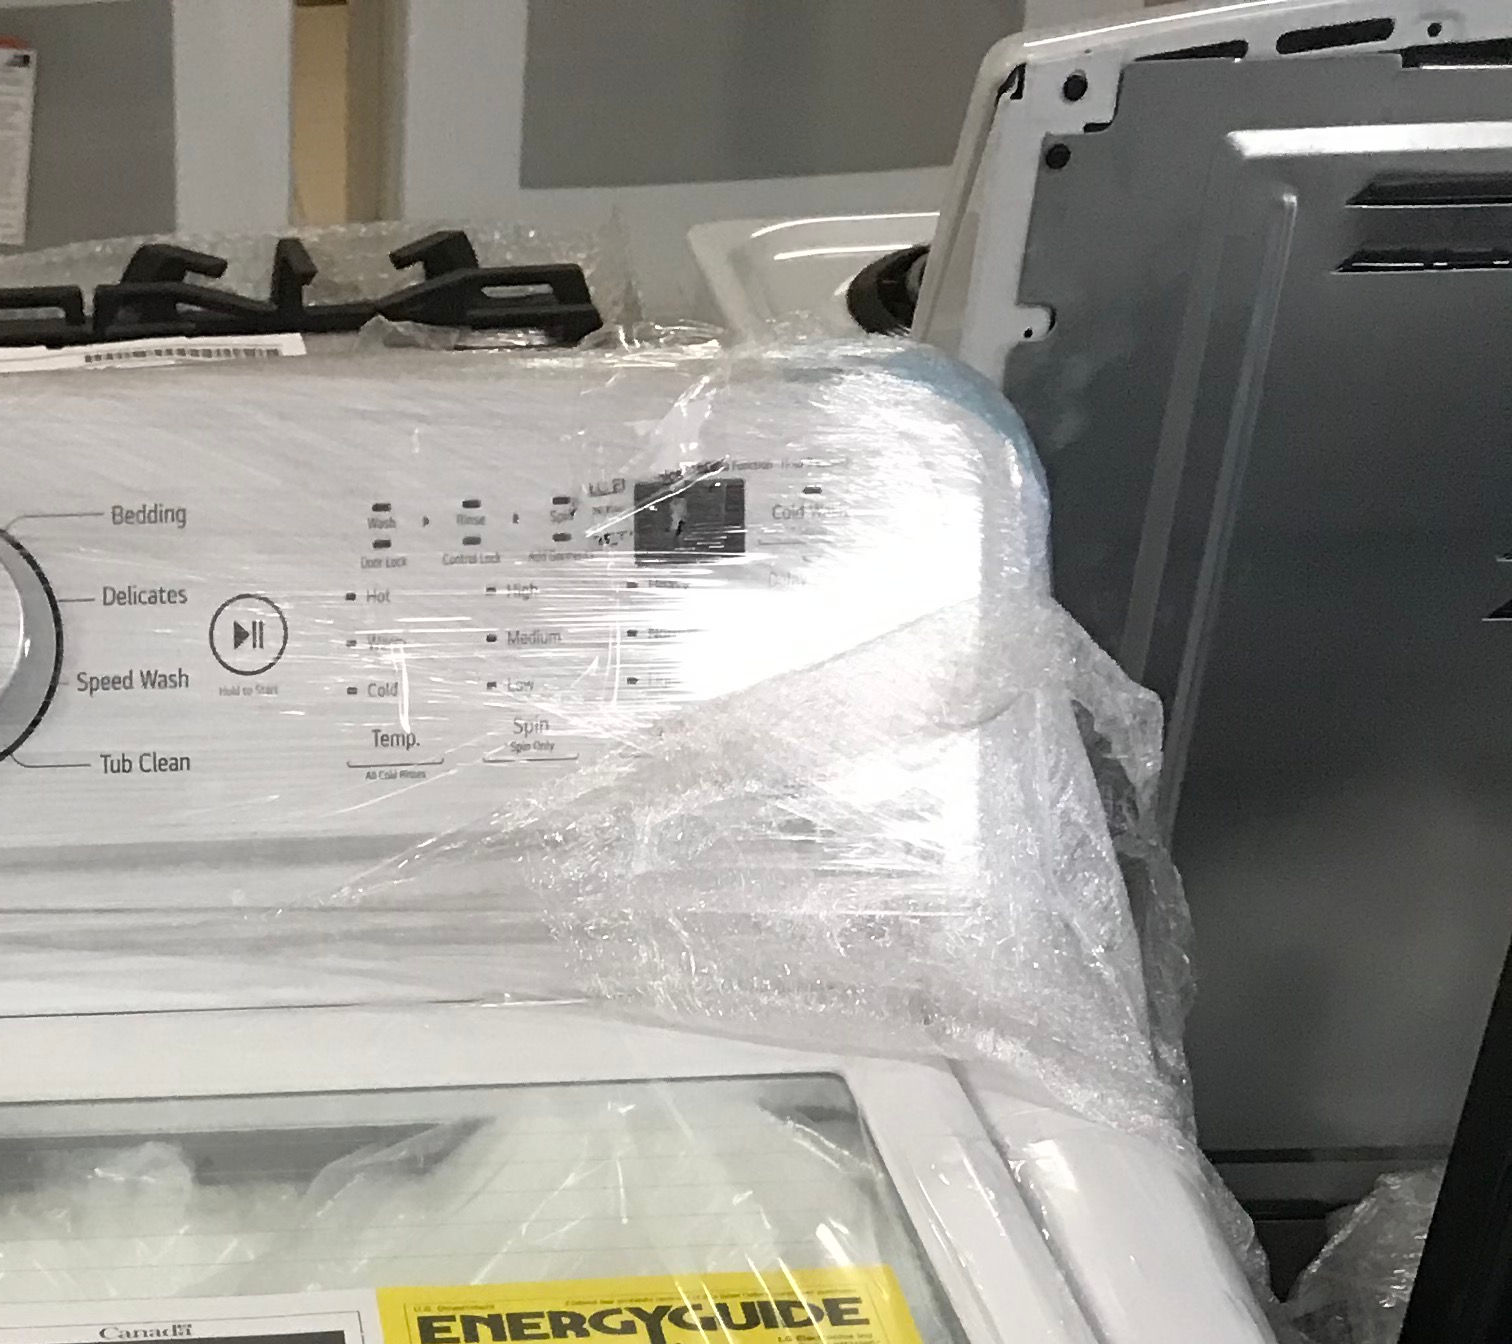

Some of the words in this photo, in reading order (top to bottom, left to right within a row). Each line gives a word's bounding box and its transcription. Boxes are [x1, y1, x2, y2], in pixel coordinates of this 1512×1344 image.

[111, 502, 187, 529] Bedding
[442, 553, 477, 566] Control
[102, 584, 188, 606] Delicates
[366, 588, 391, 603] Hot
[506, 629, 562, 647] Medium
[76, 669, 133, 698] Speed
[140, 667, 189, 690] Wash
[218, 685, 240, 697] Hold
[367, 681, 399, 698] Cold
[507, 677, 534, 692] Low
[513, 715, 550, 738] Spin
[371, 728, 421, 751] Temp.
[99, 752, 133, 774] Tub
[139, 752, 190, 773] Clean
[99, 1324, 192, 1341] Canada
